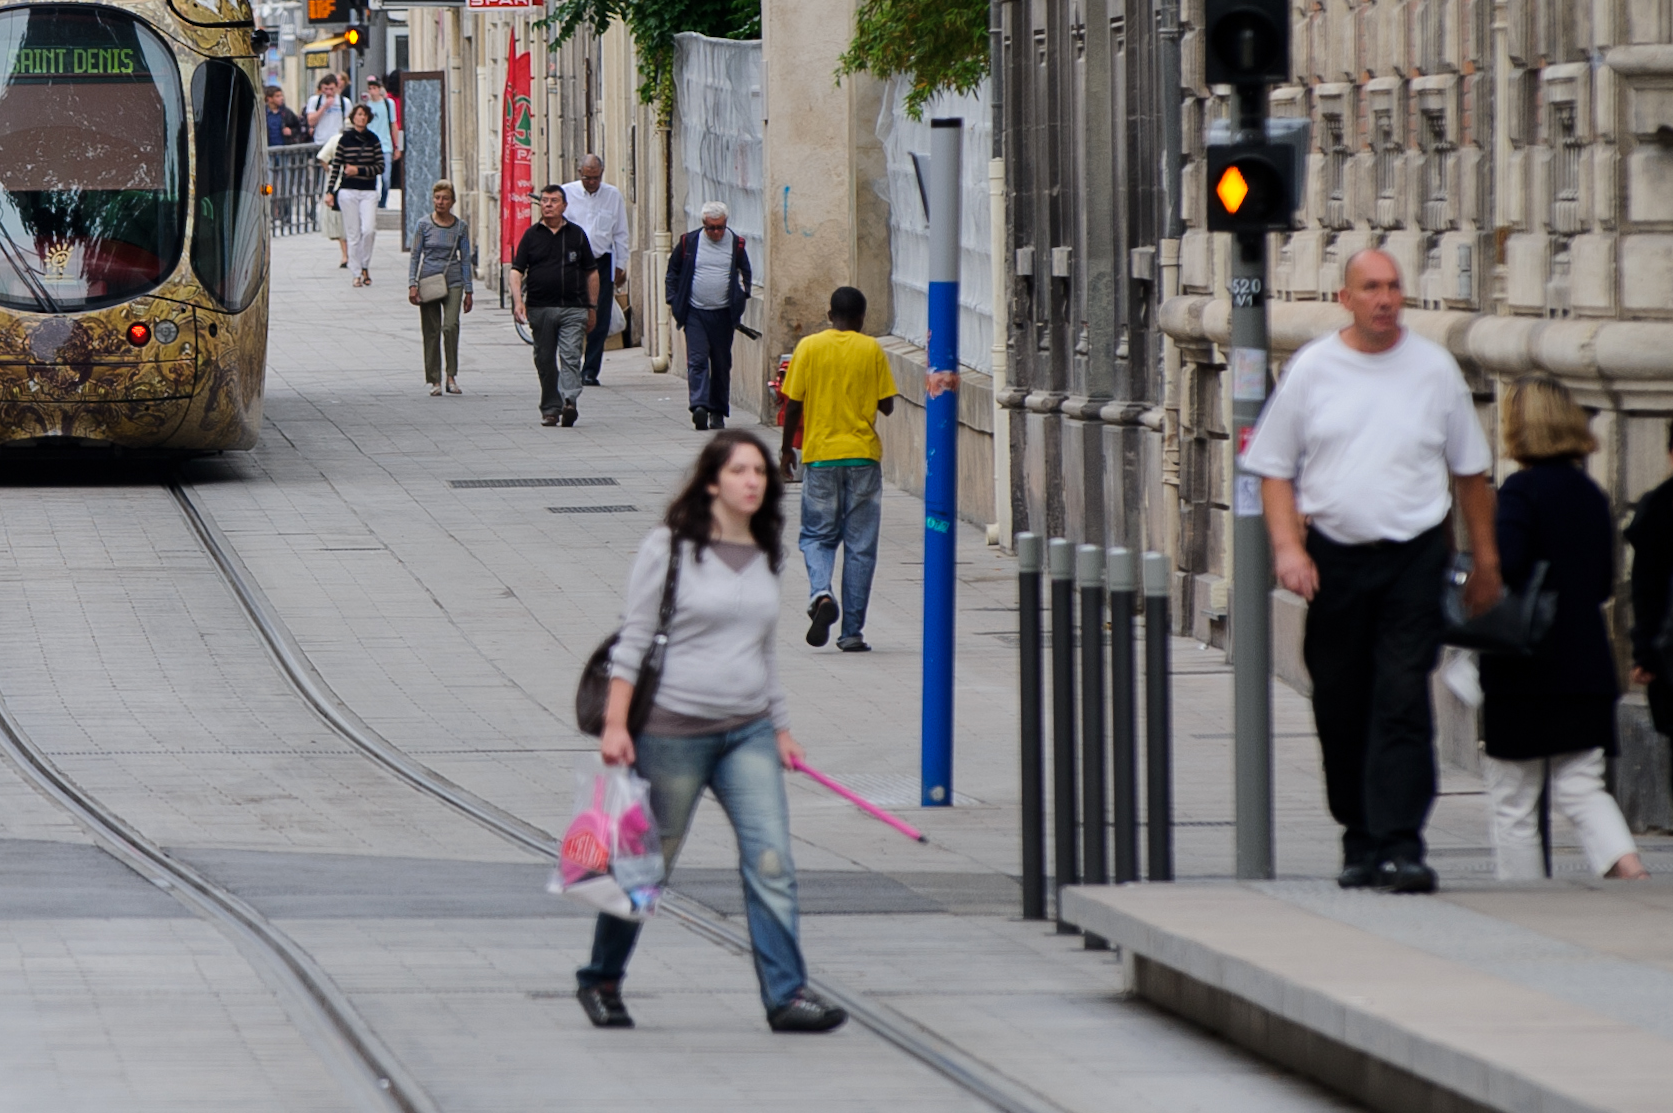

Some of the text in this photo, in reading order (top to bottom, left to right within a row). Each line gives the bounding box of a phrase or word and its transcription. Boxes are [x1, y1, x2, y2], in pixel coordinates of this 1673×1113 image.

[9, 48, 67, 74] SAINT
[73, 48, 134, 74] DENIS
[1232, 277, 1262, 294] 520
